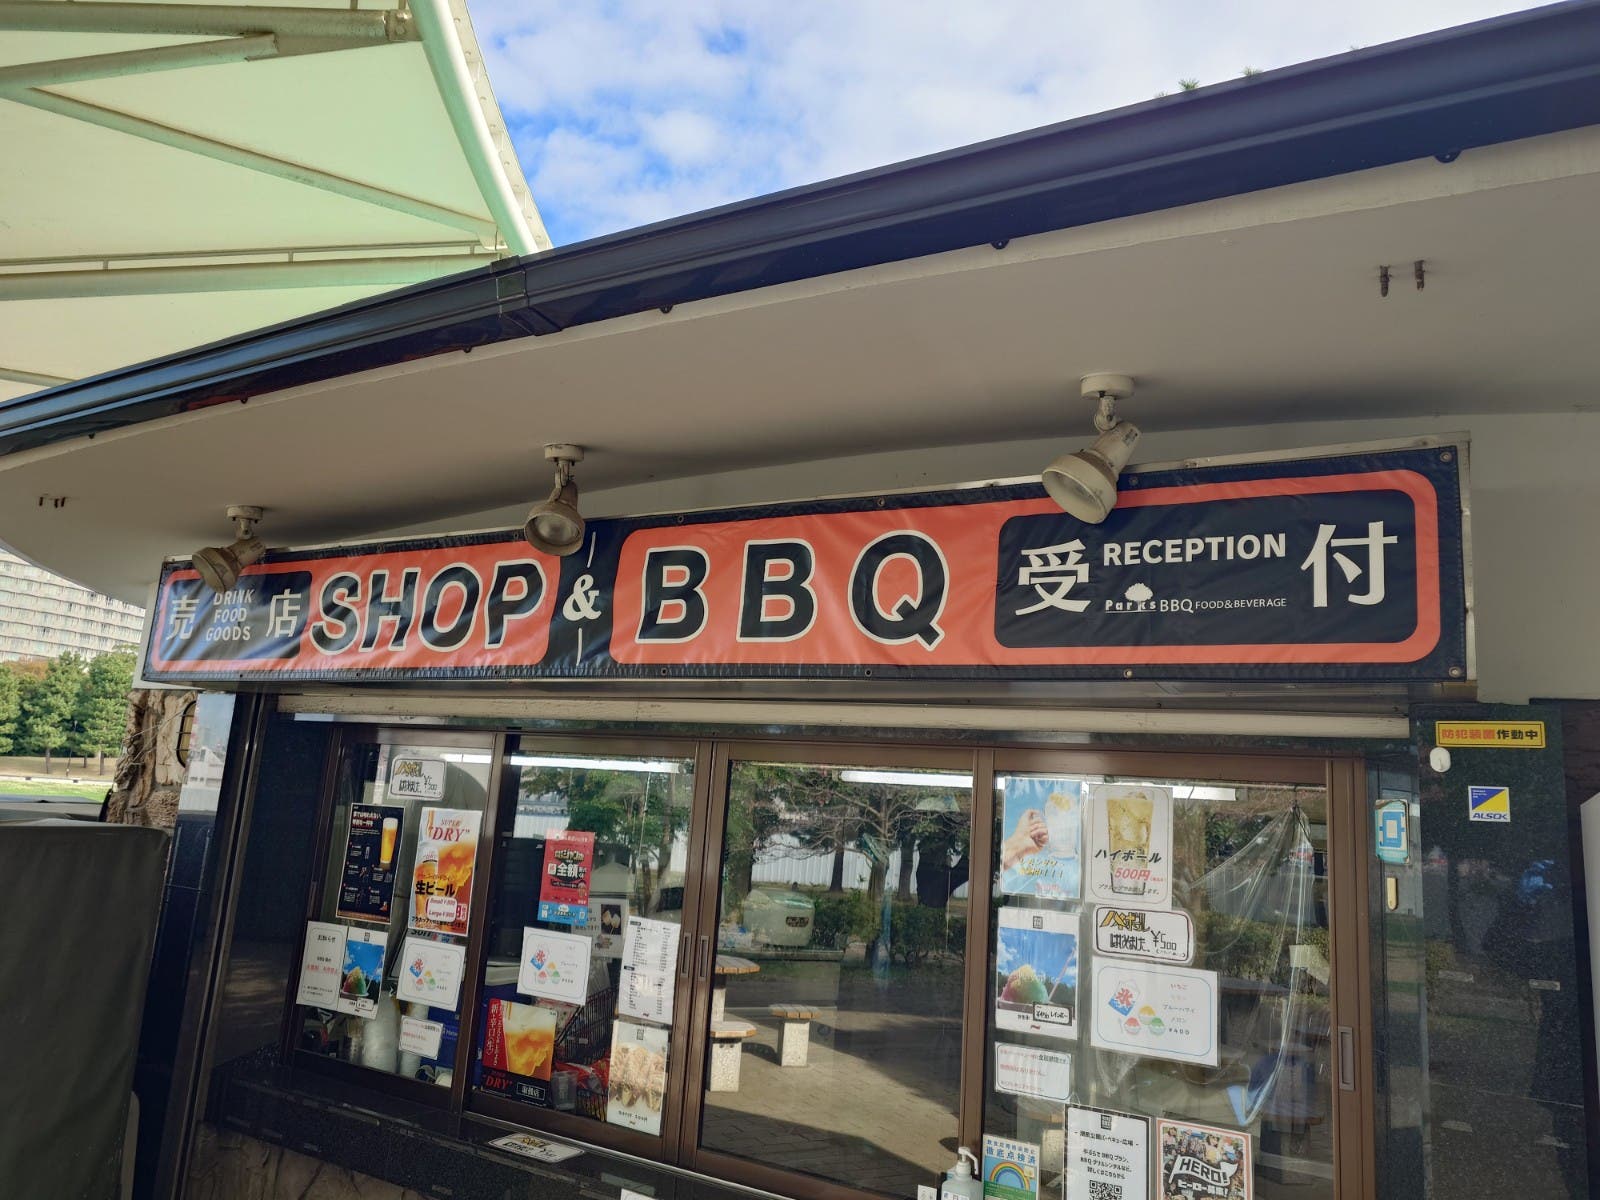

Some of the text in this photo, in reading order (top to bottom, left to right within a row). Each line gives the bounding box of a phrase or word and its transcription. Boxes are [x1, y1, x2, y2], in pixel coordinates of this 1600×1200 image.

[1103, 533, 1286, 566] RECEPTION
[1301, 521, 1398, 608] 付
[1015, 539, 1091, 615] 受
[213, 589, 254, 605] DRINK
[309, 558, 547, 655] SHOP
[562, 574, 602, 621] &
[1160, 598, 1194, 613] BBQ
[1195, 598, 1287, 610] FOOD&BEVERAGE
[166, 595, 200, 641] 売
[213, 607, 247, 623] FOOD
[266, 588, 302, 638] 店
[205, 625, 251, 641] GOODS
[1441, 729, 1538, 740] 防犯装置作動中
[1472, 812, 1507, 820] ALSOK
[1095, 849, 1162, 864] ハイボール
[415, 880, 456, 897] 生ビール
[1179, 1158, 1228, 1184] HERO!
